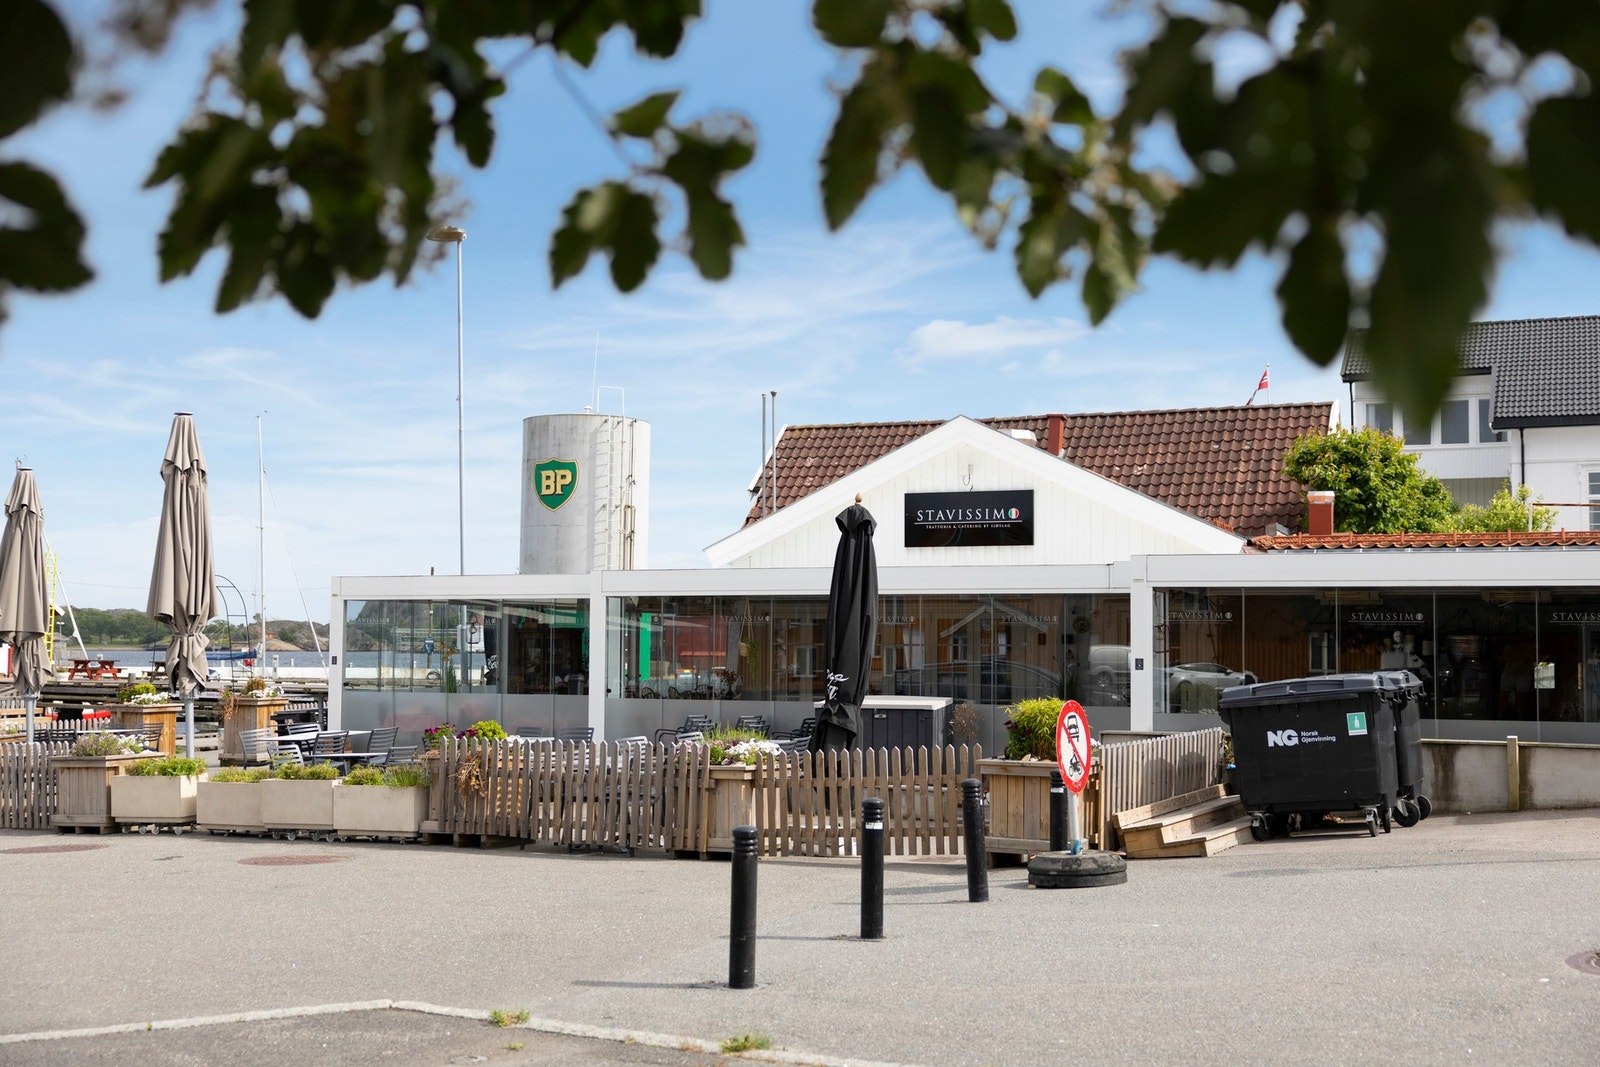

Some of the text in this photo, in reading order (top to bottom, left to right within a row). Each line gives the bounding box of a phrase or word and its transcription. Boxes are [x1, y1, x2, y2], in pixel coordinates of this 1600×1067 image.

[540, 469, 573, 496] BP
[917, 508, 1020, 522] STAVISSIMO
[1351, 612, 1424, 621] STAVISSIMO
[1267, 729, 1299, 747] NG
